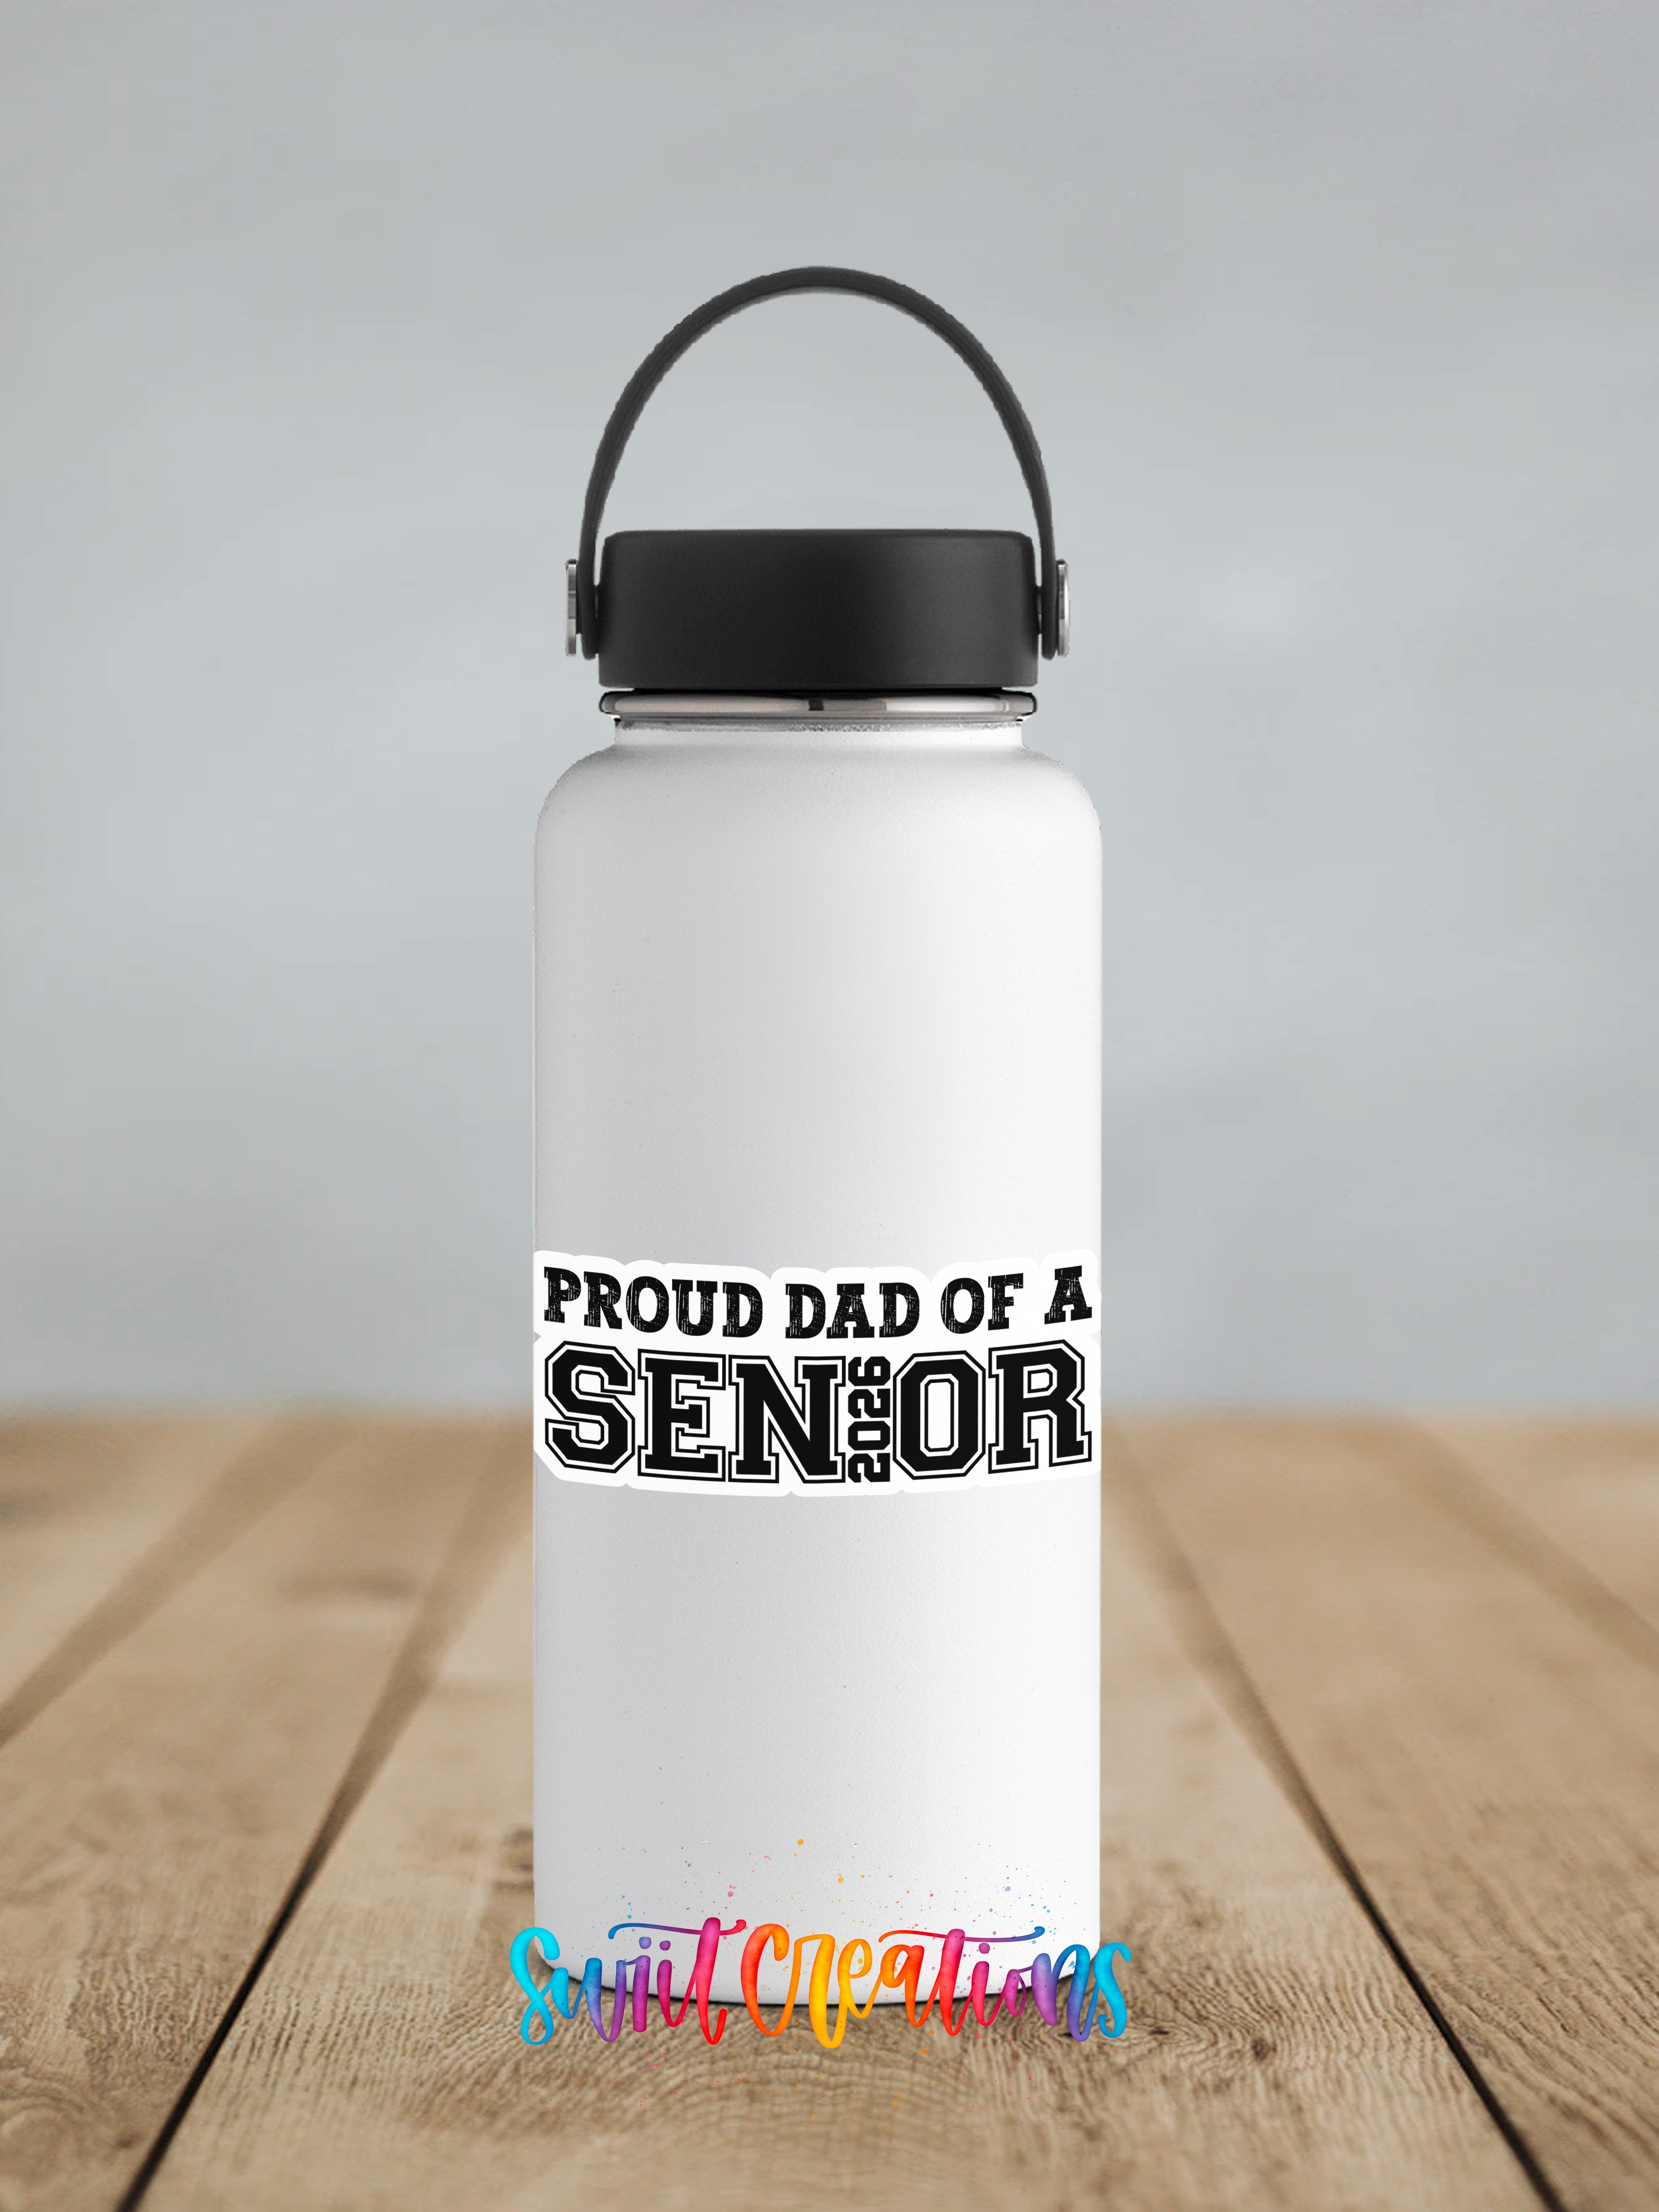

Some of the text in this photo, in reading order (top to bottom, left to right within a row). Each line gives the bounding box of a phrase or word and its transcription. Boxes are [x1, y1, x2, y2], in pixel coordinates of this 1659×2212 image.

[544, 1265, 1092, 1339] PROUD DAD OF A
[847, 1356, 891, 1483] 2026
